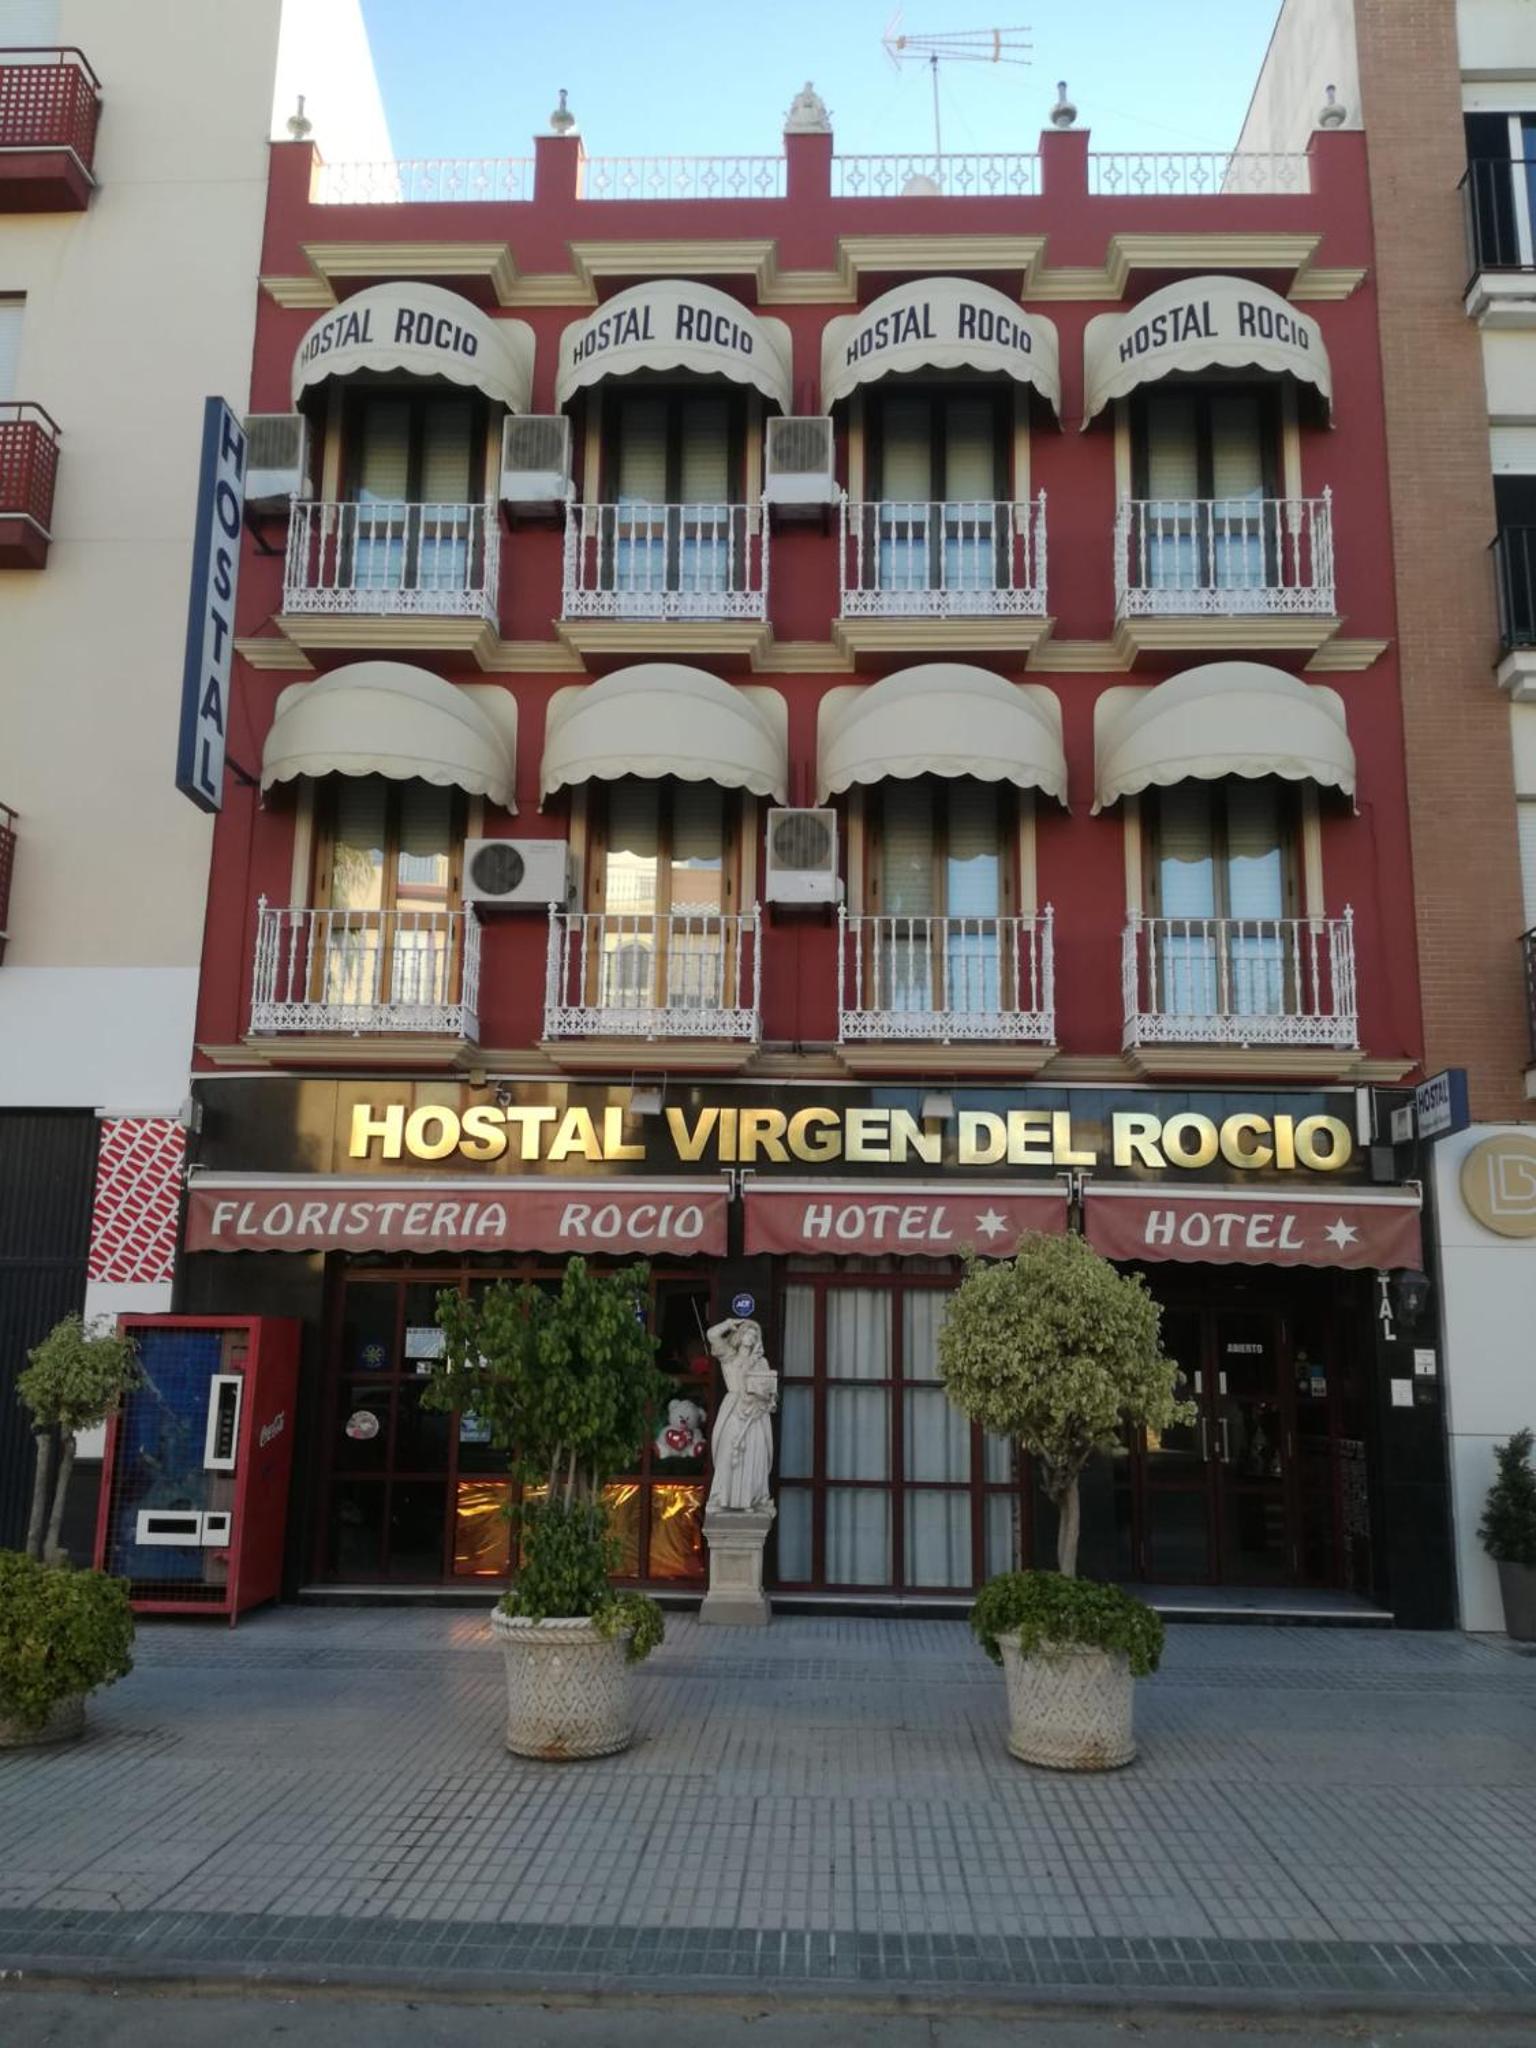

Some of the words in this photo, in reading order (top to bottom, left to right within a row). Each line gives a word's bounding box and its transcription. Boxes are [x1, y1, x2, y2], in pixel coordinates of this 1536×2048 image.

[301, 308, 373, 366] HOSTAL
[394, 307, 478, 357] ROCIO
[573, 304, 655, 365] HOSTAL
[675, 304, 753, 354] ROCIO
[846, 302, 936, 365] HOSTAL
[958, 303, 1032, 353] ROCIO
[1119, 300, 1218, 363] HOSTAL
[1238, 301, 1309, 350] ROCIO
[198, 412, 244, 797] HOSTAL
[1418, 1080, 1449, 1114] HOSTAL
[349, 1104, 645, 1162] HOSTAL
[665, 1106, 942, 1165] VIRGEN
[958, 1108, 1097, 1168] DEL
[1112, 1111, 1352, 1172] ROCIO
[210, 1201, 508, 1237] FLORISTERIA
[558, 1202, 704, 1239] ROCIO
[801, 1205, 952, 1240] HOTEL
[1144, 1209, 1305, 1251] HOTEL
[1226, 1343, 1263, 1354] ABIERTO
